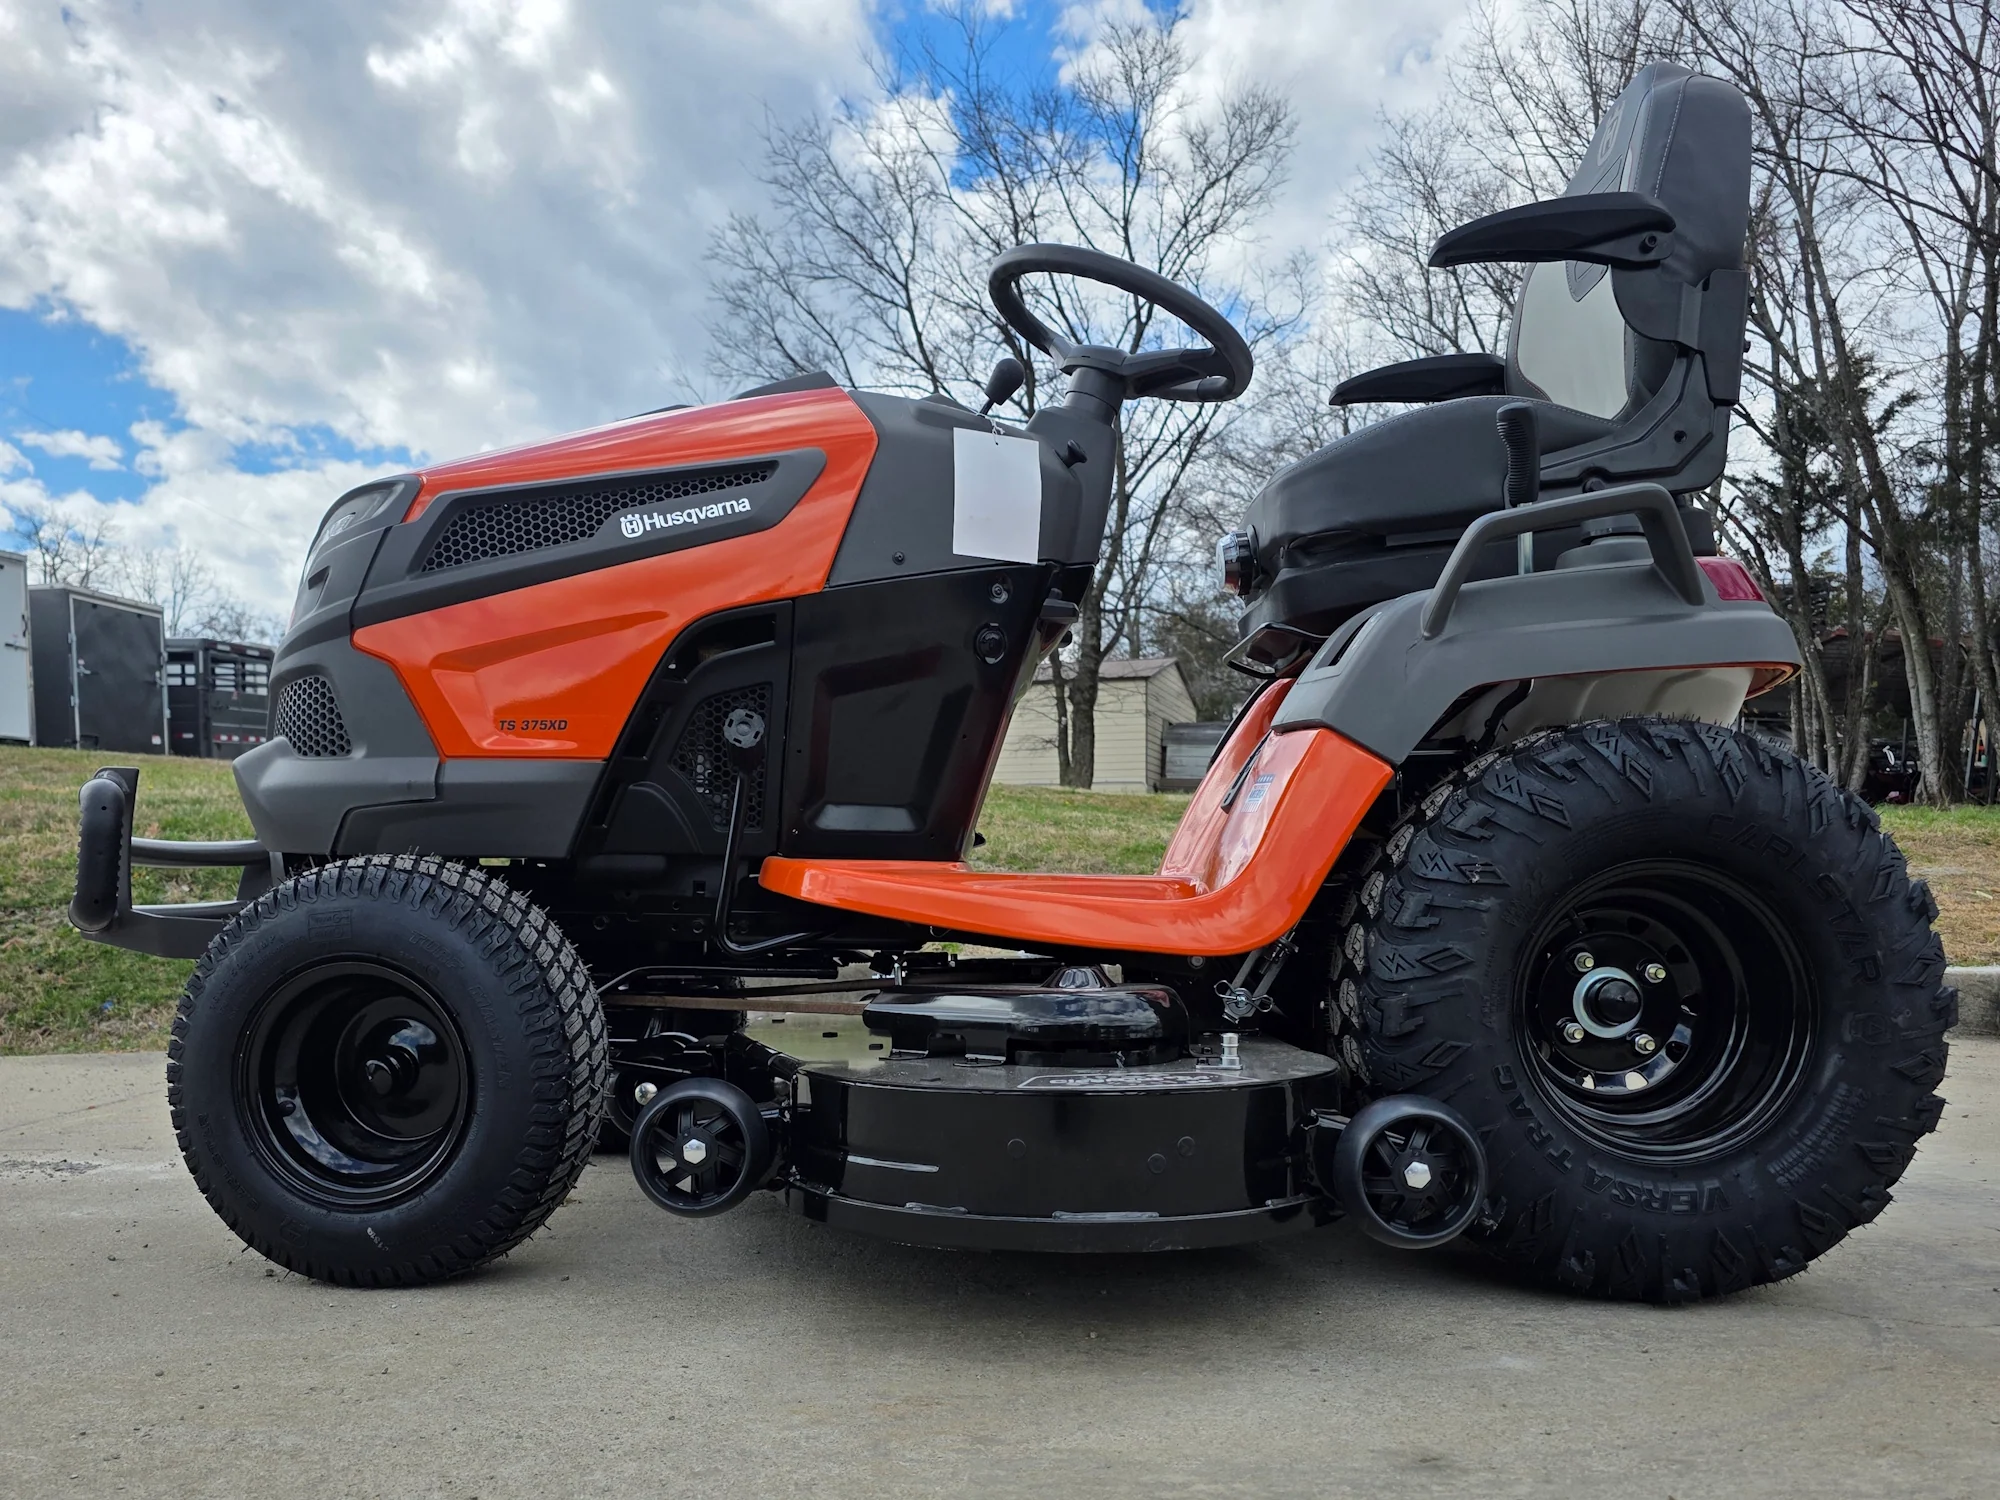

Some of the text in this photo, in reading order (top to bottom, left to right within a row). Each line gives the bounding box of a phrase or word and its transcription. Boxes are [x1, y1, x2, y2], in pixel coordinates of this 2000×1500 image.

[643, 498, 751, 531] Husqvarna
[499, 720, 568, 731] TS 375XD
[1583, 1166, 1733, 1216] VERSA
